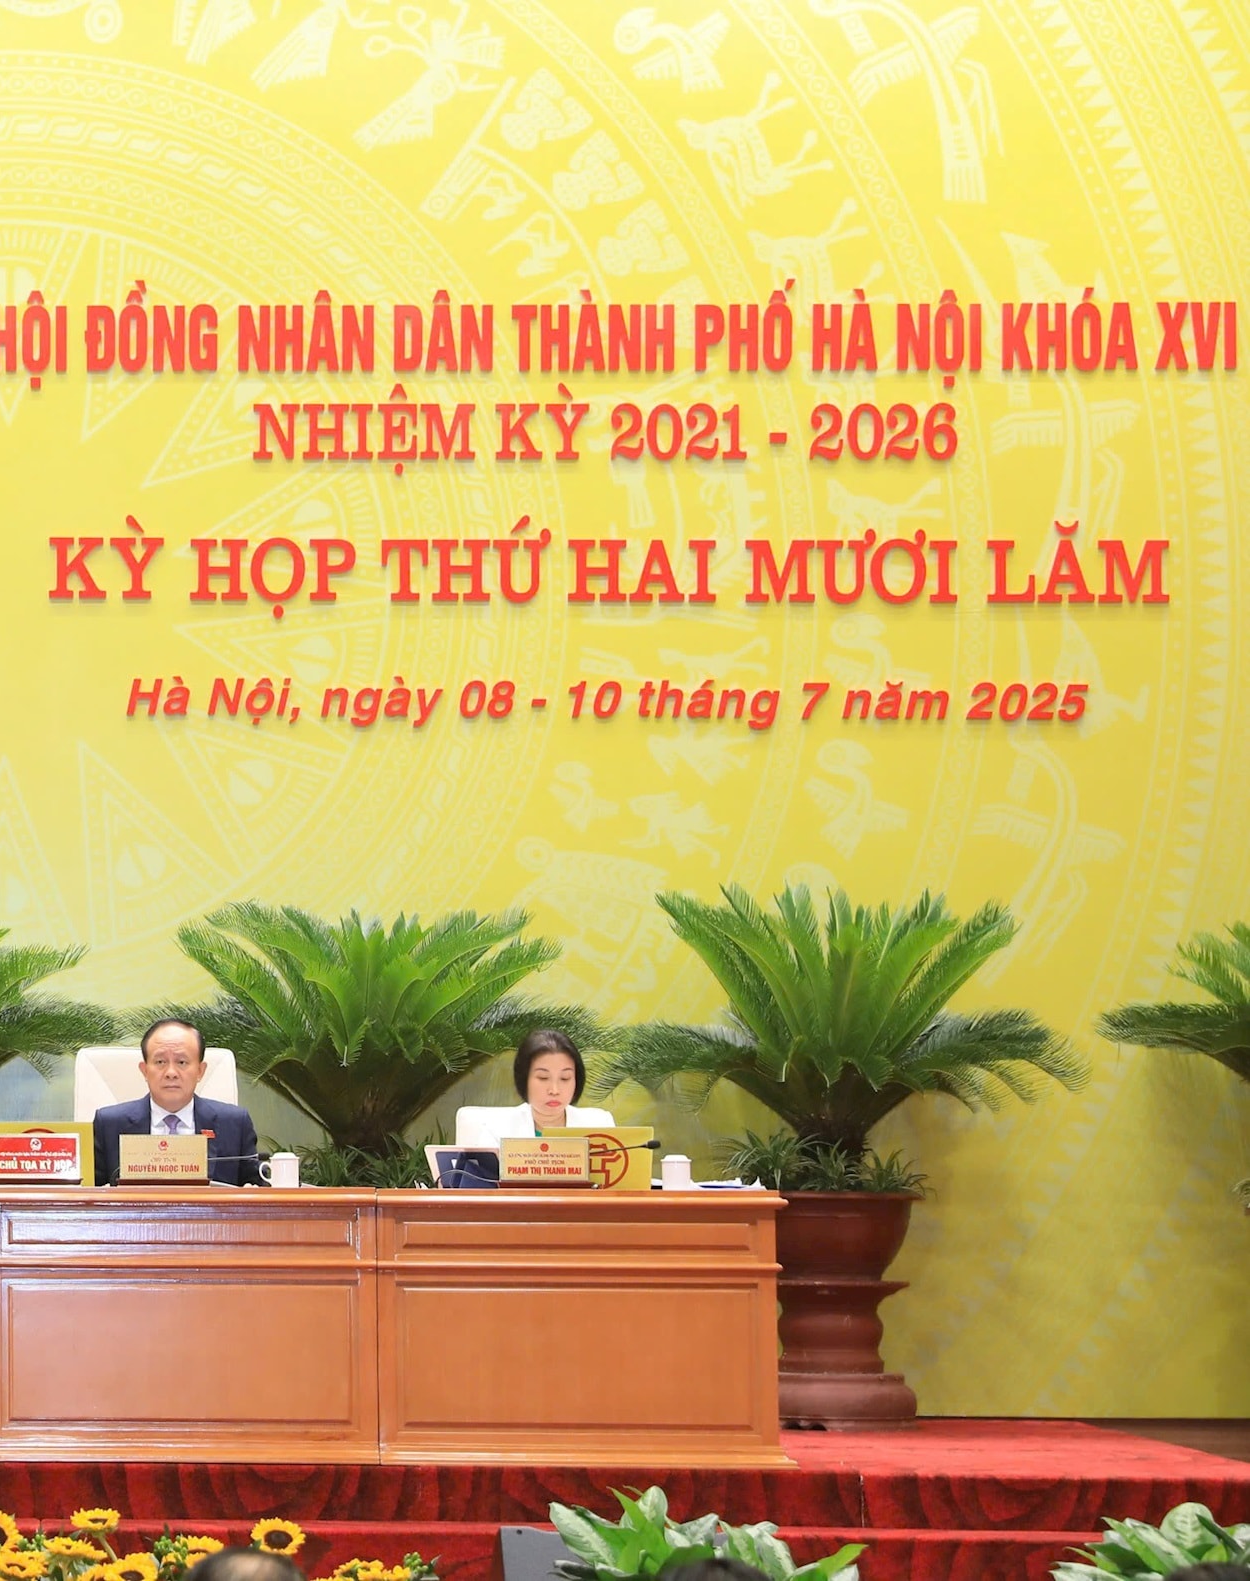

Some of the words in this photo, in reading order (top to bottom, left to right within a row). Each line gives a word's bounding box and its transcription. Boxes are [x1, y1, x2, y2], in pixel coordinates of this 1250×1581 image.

[84, 279, 218, 374] ĐỒNG
[237, 289, 375, 374] NHÂN
[393, 289, 494, 374] DÂN
[511, 289, 675, 374] THÀNH
[694, 278, 795, 374] PHỐ
[811, 288, 878, 373] HÀ
[896, 289, 982, 390] NỘI
[1001, 287, 1139, 373] KHÓA
[1155, 301, 1238, 372] XVI
[252, 383, 476, 477] NHIỆM
[495, 382, 590, 462] KỲ
[610, 402, 748, 463] 2021
[769, 432, 788, 445] -
[809, 402, 958, 463] 2026
[48, 514, 165, 602] KỲ
[189, 537, 357, 620] HỌP
[381, 514, 552, 605] THỨ
[567, 539, 717, 604] HAI
[745, 528, 958, 606] MƯƠI
[986, 520, 1171, 605] LĂM
[126, 675, 191, 718] Hà
[207, 677, 301, 726] Nội,
[320, 675, 444, 729] ngày
[459, 680, 516, 720] 08
[531, 698, 547, 709] -
[568, 680, 622, 720] 10
[638, 679, 781, 732] tháng
[801, 682, 831, 721] 7
[842, 680, 950, 722] năm
[965, 681, 1089, 724] 2025
[507, 1166, 528, 1176] PHẠM
[530, 1166, 541, 1176] THỊ
[543, 1166, 566, 1175] THANH
[568, 1167, 582, 1175] MAI
